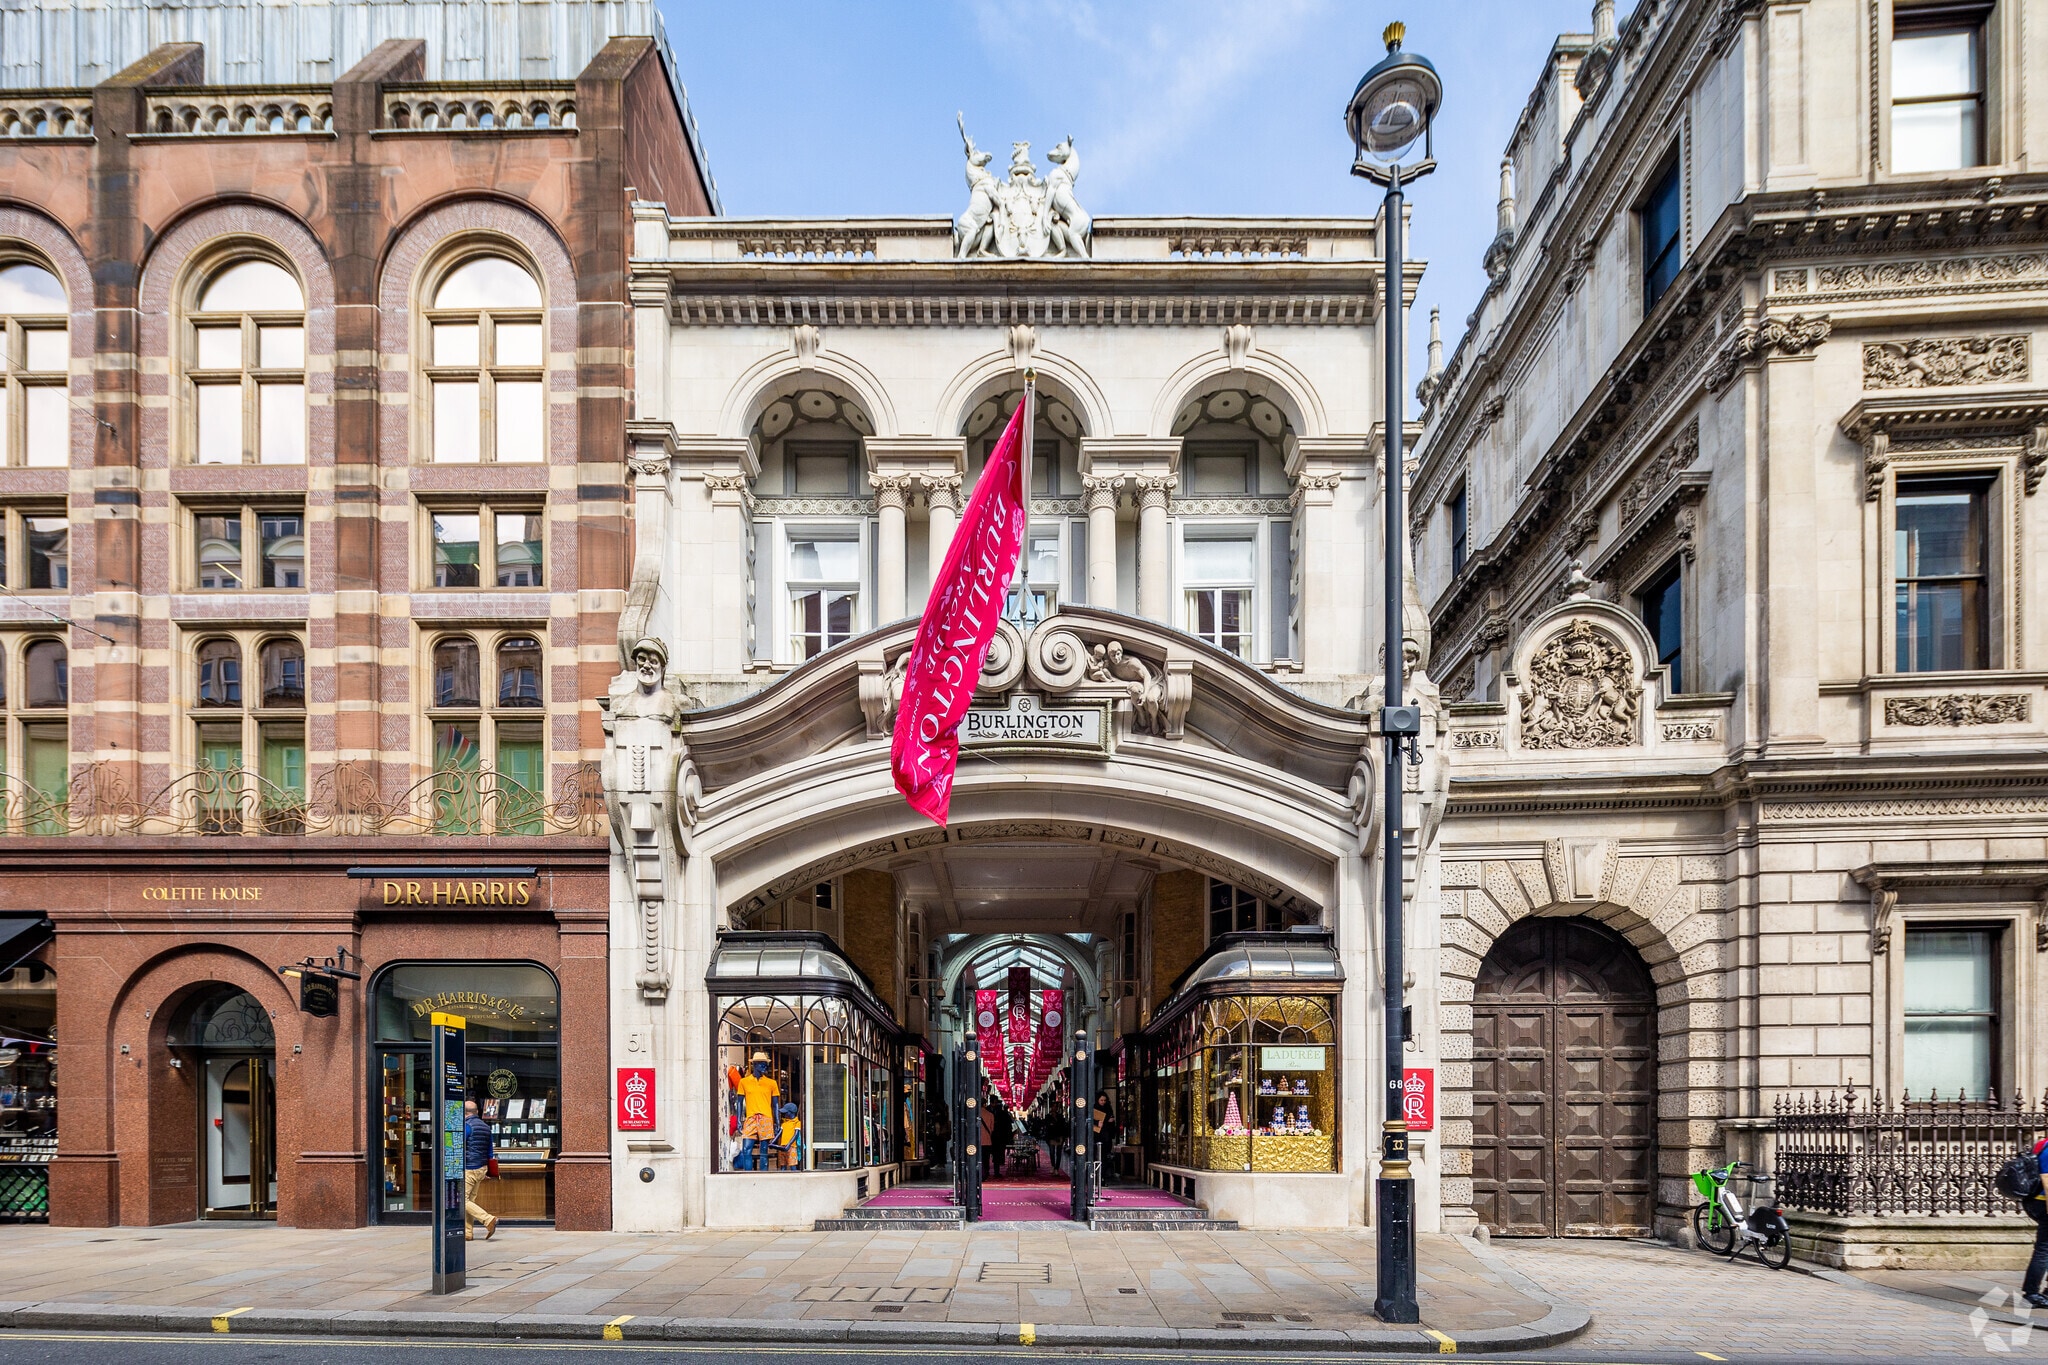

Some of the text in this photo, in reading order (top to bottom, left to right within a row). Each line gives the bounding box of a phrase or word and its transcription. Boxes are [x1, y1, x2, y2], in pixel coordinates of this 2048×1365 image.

[916, 492, 1006, 776] BURLINGTON
[909, 691, 922, 741] LONDON
[967, 712, 1084, 731] BURLINGTON
[1001, 729, 1049, 739] ARCADE
[142, 887, 263, 901] COLETTE HOUSE
[628, 1034, 647, 1053] 51
[1267, 1049, 1321, 1060] LADURÉE
[1389, 1080, 1403, 1089] 68
